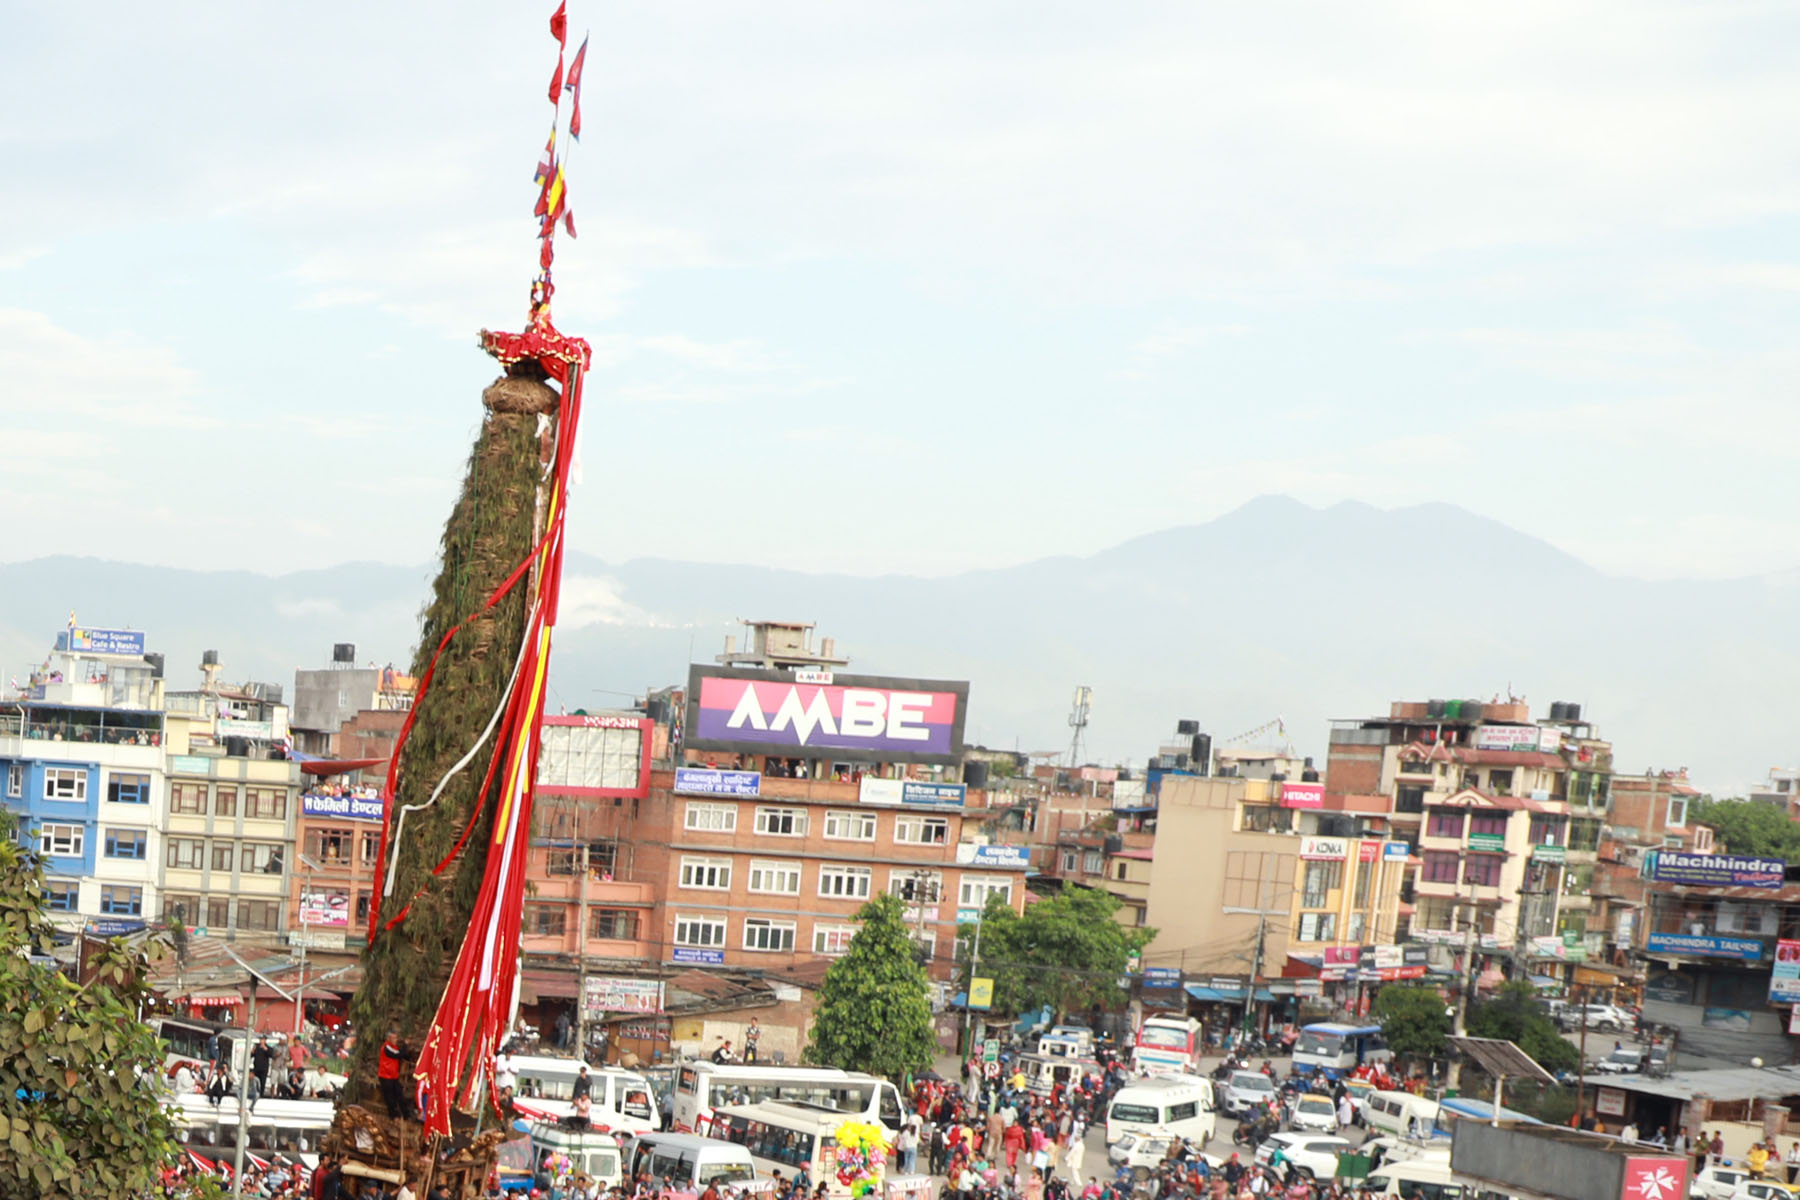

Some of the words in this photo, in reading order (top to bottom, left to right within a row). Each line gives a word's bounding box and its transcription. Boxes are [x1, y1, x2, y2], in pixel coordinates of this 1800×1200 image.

[92, 631, 109, 640] Blue
[109, 632, 135, 642] Square
[92, 640, 108, 648] Cafe
[116, 641, 140, 650] Restro
[725, 681, 934, 747] AMBE
[1283, 791, 1321, 801] HITACHI
[1659, 853, 1784, 873] Machhindra
